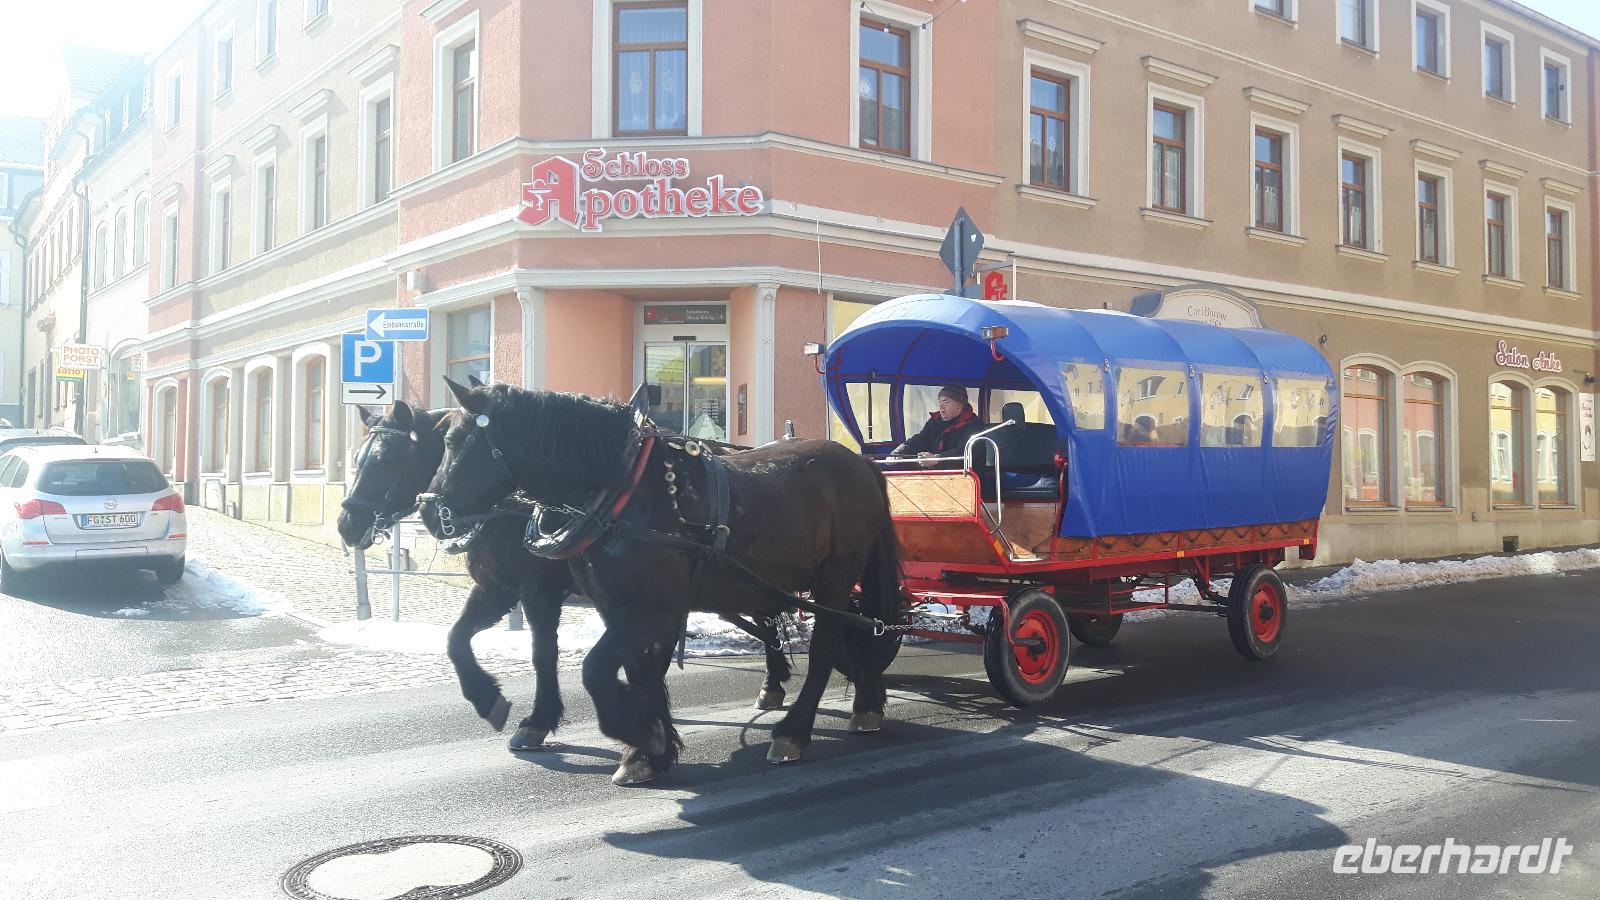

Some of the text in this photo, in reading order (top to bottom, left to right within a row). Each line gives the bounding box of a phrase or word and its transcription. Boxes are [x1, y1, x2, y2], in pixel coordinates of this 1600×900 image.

[582, 149, 689, 181] Schloss
[515, 155, 764, 232] Apotheke
[383, 320, 425, 329] Einbahnstraße
[64, 346, 99, 355] PHOTO
[64, 354, 98, 363] PORST
[354, 340, 382, 377] P
[1496, 340, 1530, 369] Salon
[87, 513, 136, 525] FG ST 600
